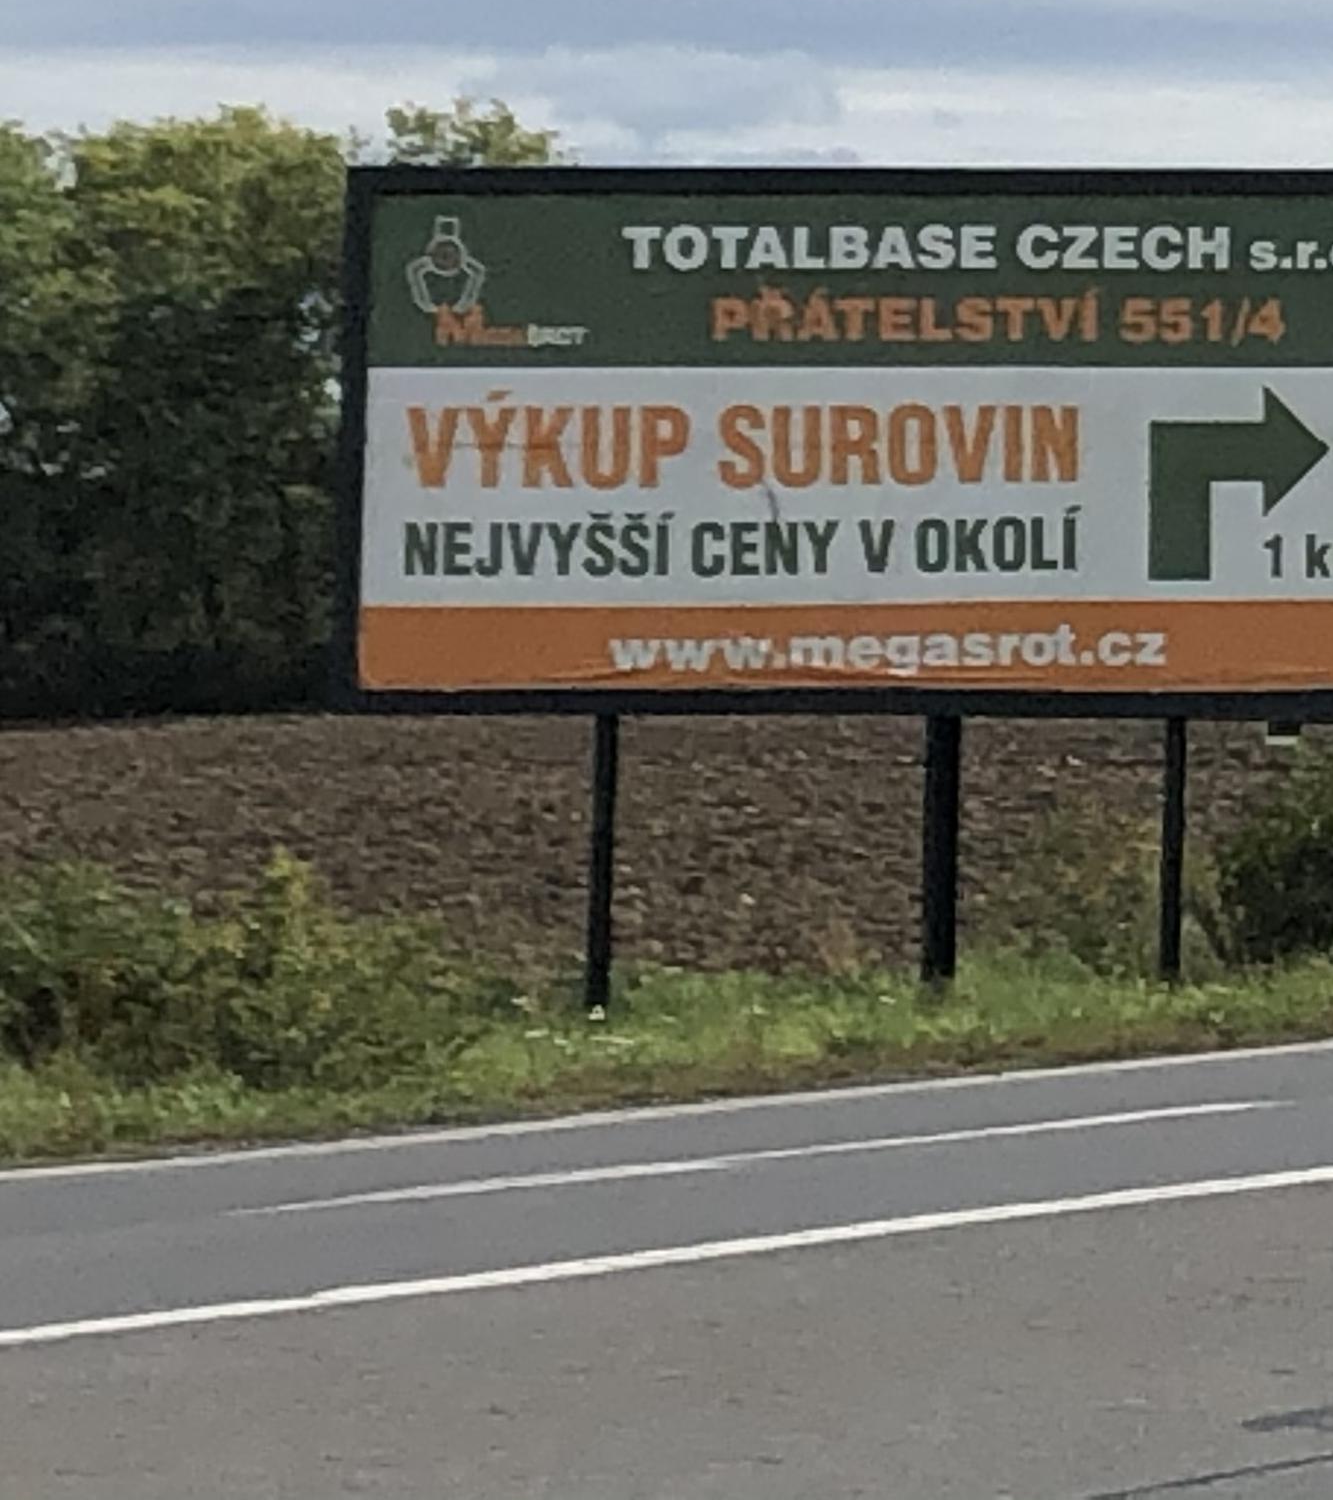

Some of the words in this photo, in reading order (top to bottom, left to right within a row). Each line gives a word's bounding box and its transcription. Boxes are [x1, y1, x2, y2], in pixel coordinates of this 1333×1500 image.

[621, 224, 998, 272] TOTALBASE
[1016, 223, 1231, 271] CZECH
[711, 284, 1099, 343] PŘÁTELSTVÍ
[1118, 295, 1286, 348] 551/4
[406, 389, 692, 490] VÝKUP
[717, 403, 1080, 489] SUROVIN
[404, 511, 676, 578] NEJVYŠŠÍ
[691, 518, 841, 578] CENY
[858, 518, 896, 573] V
[915, 504, 1083, 573] OKOLÍ
[1263, 533, 1283, 578] 1
[608, 624, 1168, 677] www.megasrot.cz
